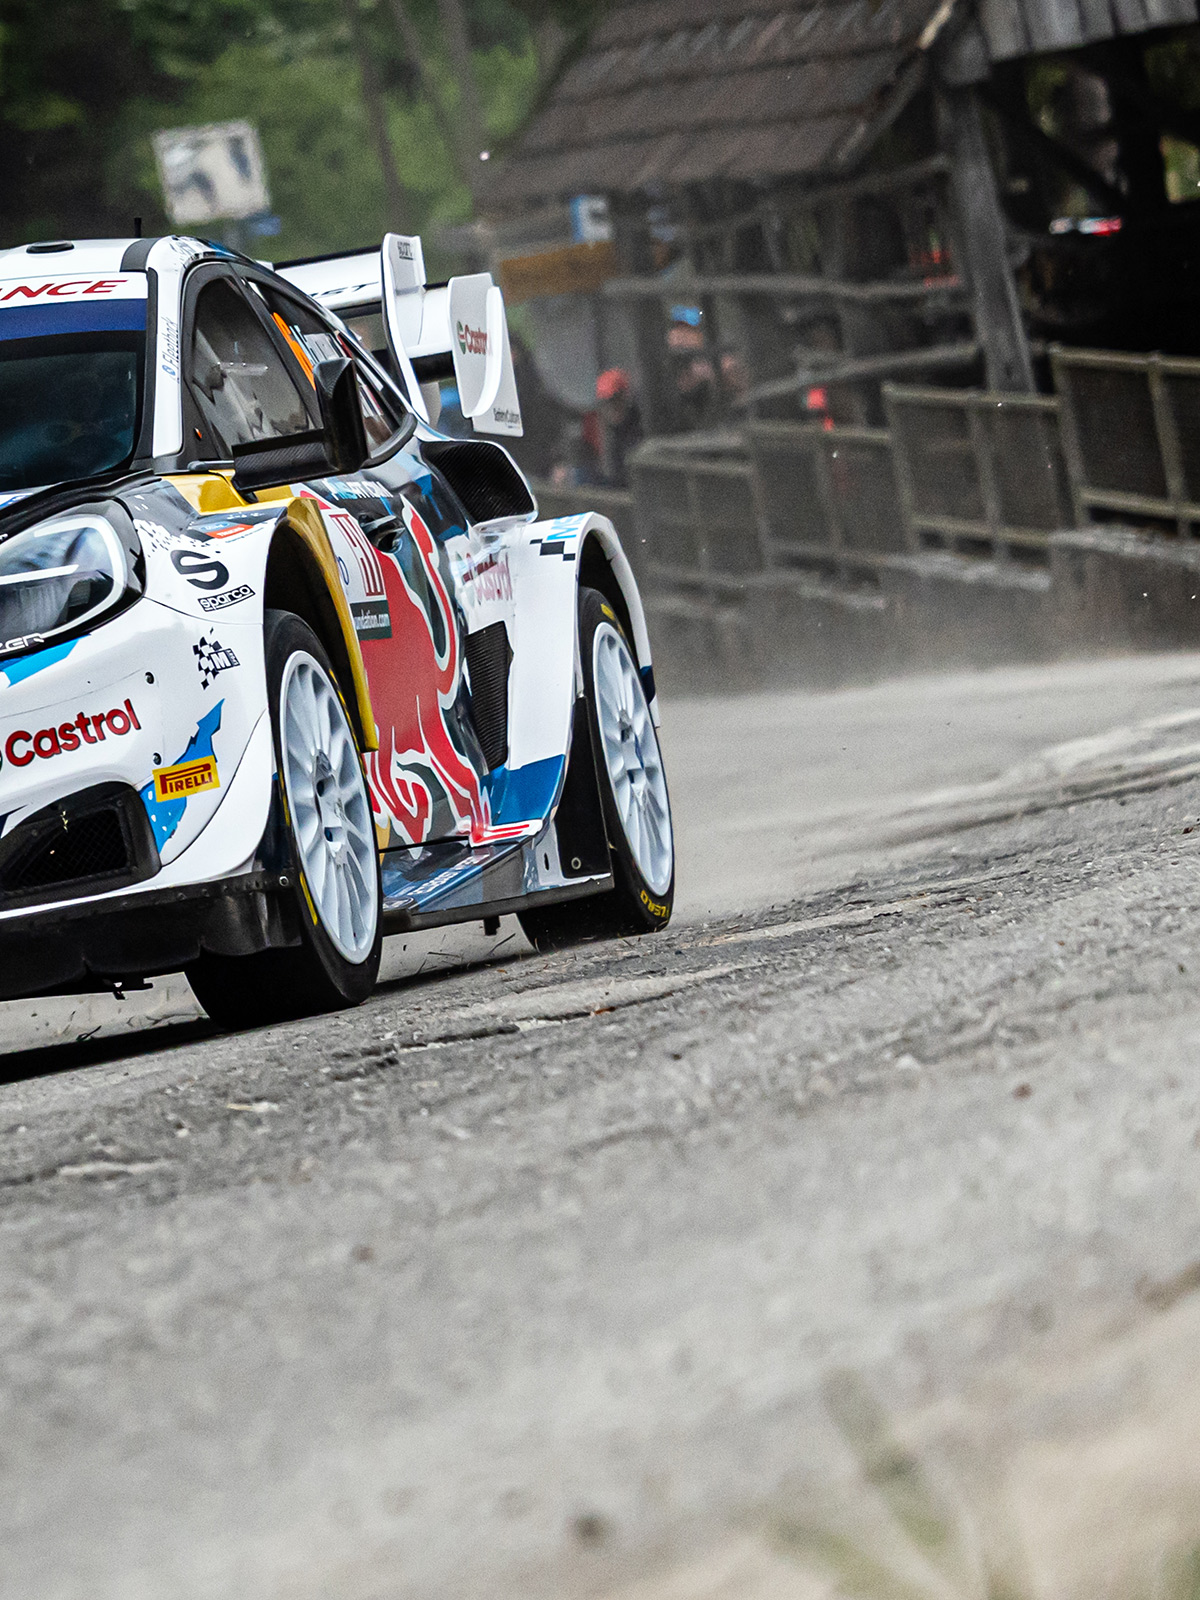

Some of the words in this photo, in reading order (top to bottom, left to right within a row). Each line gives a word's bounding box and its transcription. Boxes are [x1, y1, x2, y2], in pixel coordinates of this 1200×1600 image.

[170, 549, 230, 591] S
[200, 585, 252, 610] sparco
[4, 698, 142, 767] Castrol
[159, 763, 214, 795] PIRELLI
